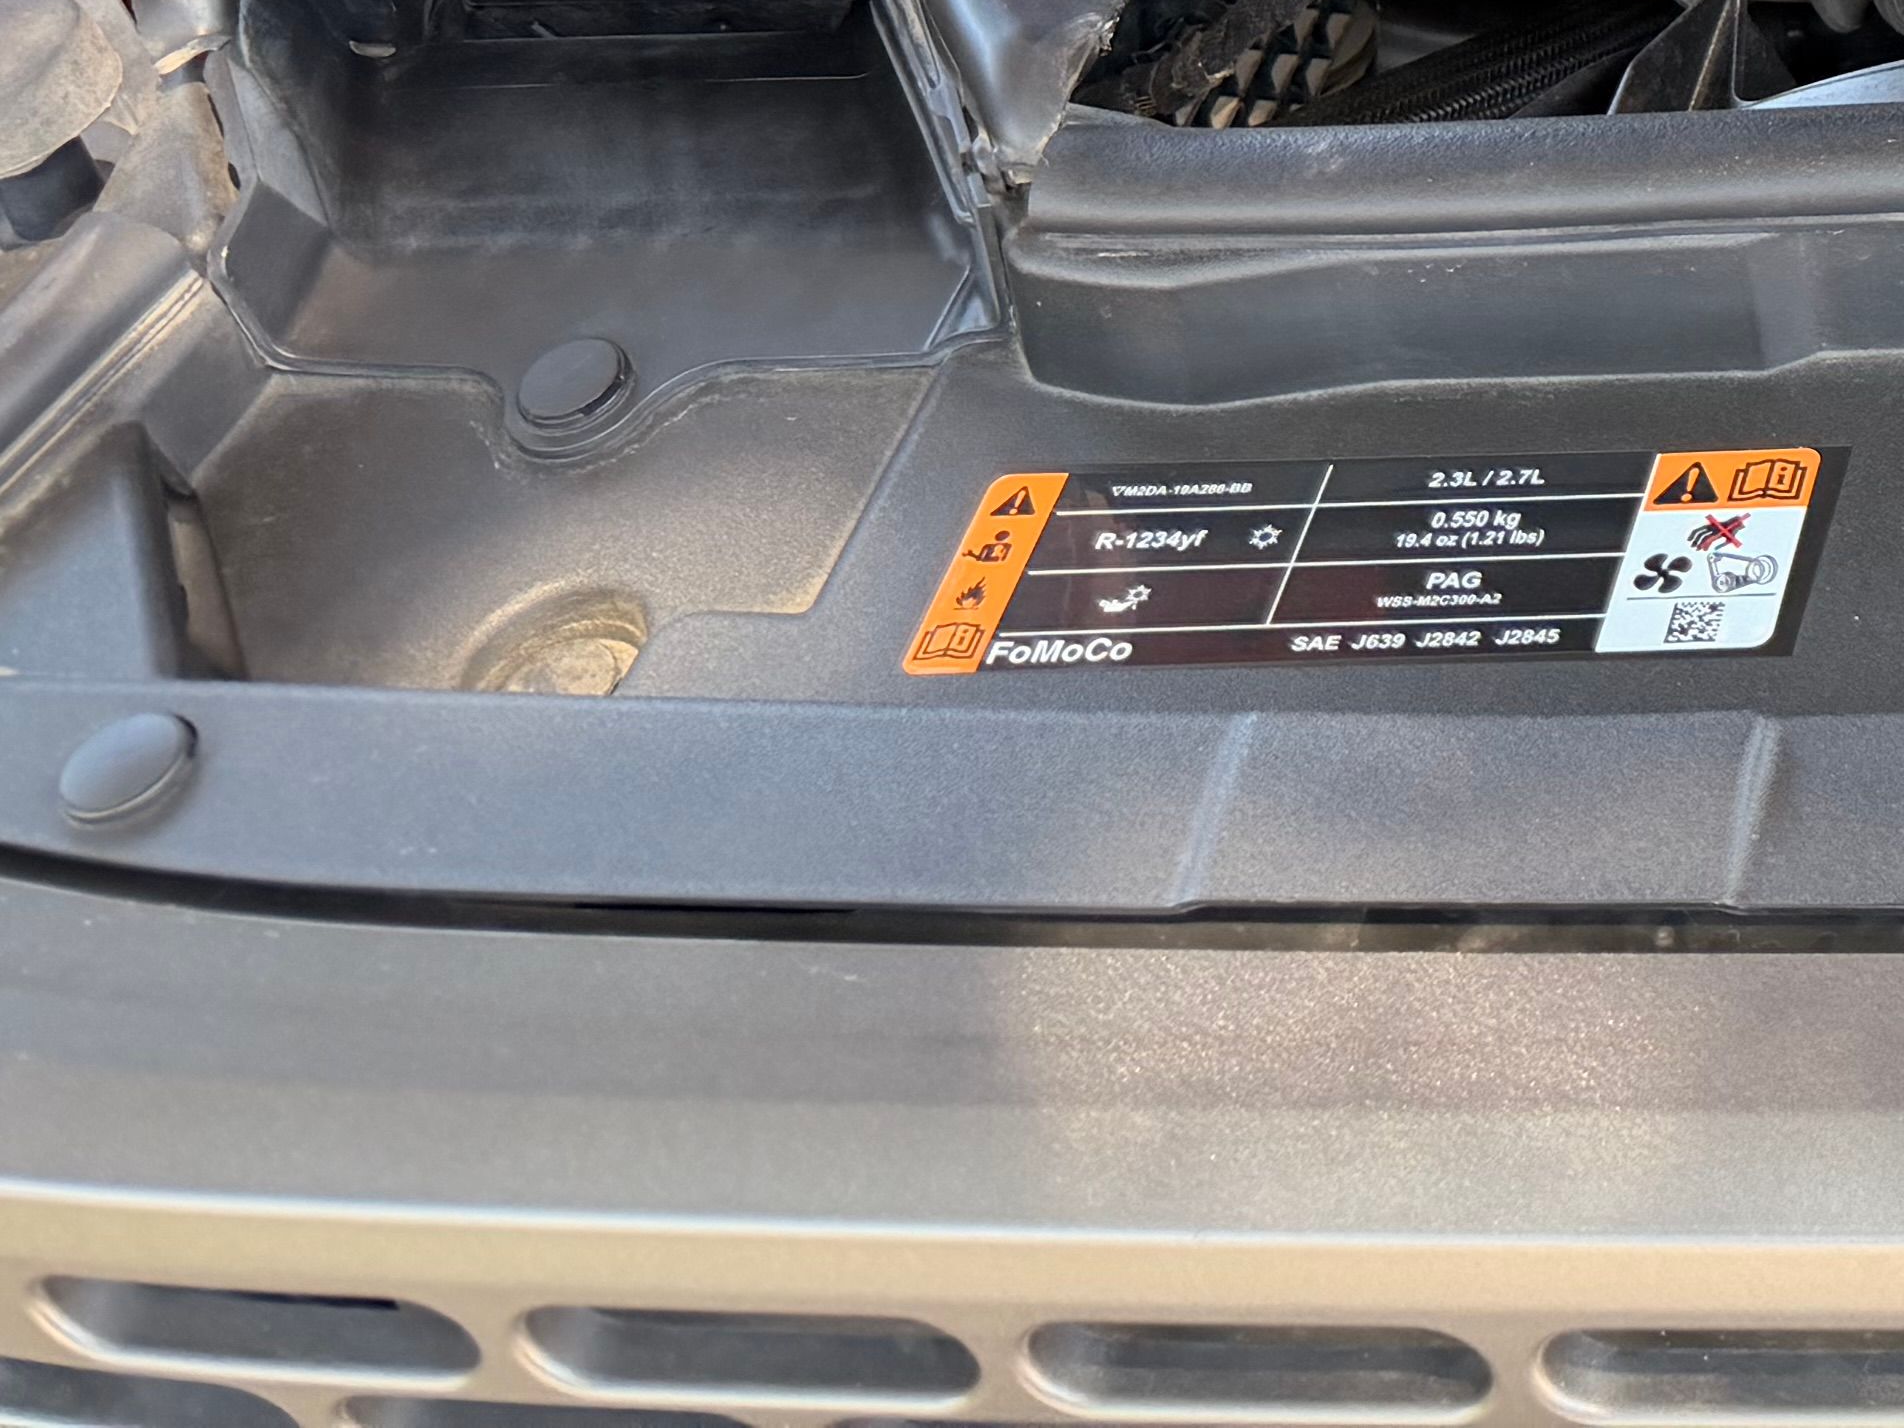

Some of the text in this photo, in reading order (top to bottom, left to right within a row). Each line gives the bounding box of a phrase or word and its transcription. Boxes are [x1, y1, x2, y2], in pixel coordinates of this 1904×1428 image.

[1428, 469, 1545, 488] 2.3L / 2.7L
[1430, 510, 1522, 530] 0.550 kg
[1095, 529, 1209, 552] R-1234yf
[1396, 528, 1545, 550] 19.4 oz (1.21 lbs)
[1426, 571, 1483, 590] PAG
[1376, 593, 1503, 608] WSS-M2C300-A2
[1290, 628, 1561, 652] SAE J639 J2842 J2845
[986, 638, 1133, 665] FoMoCo
